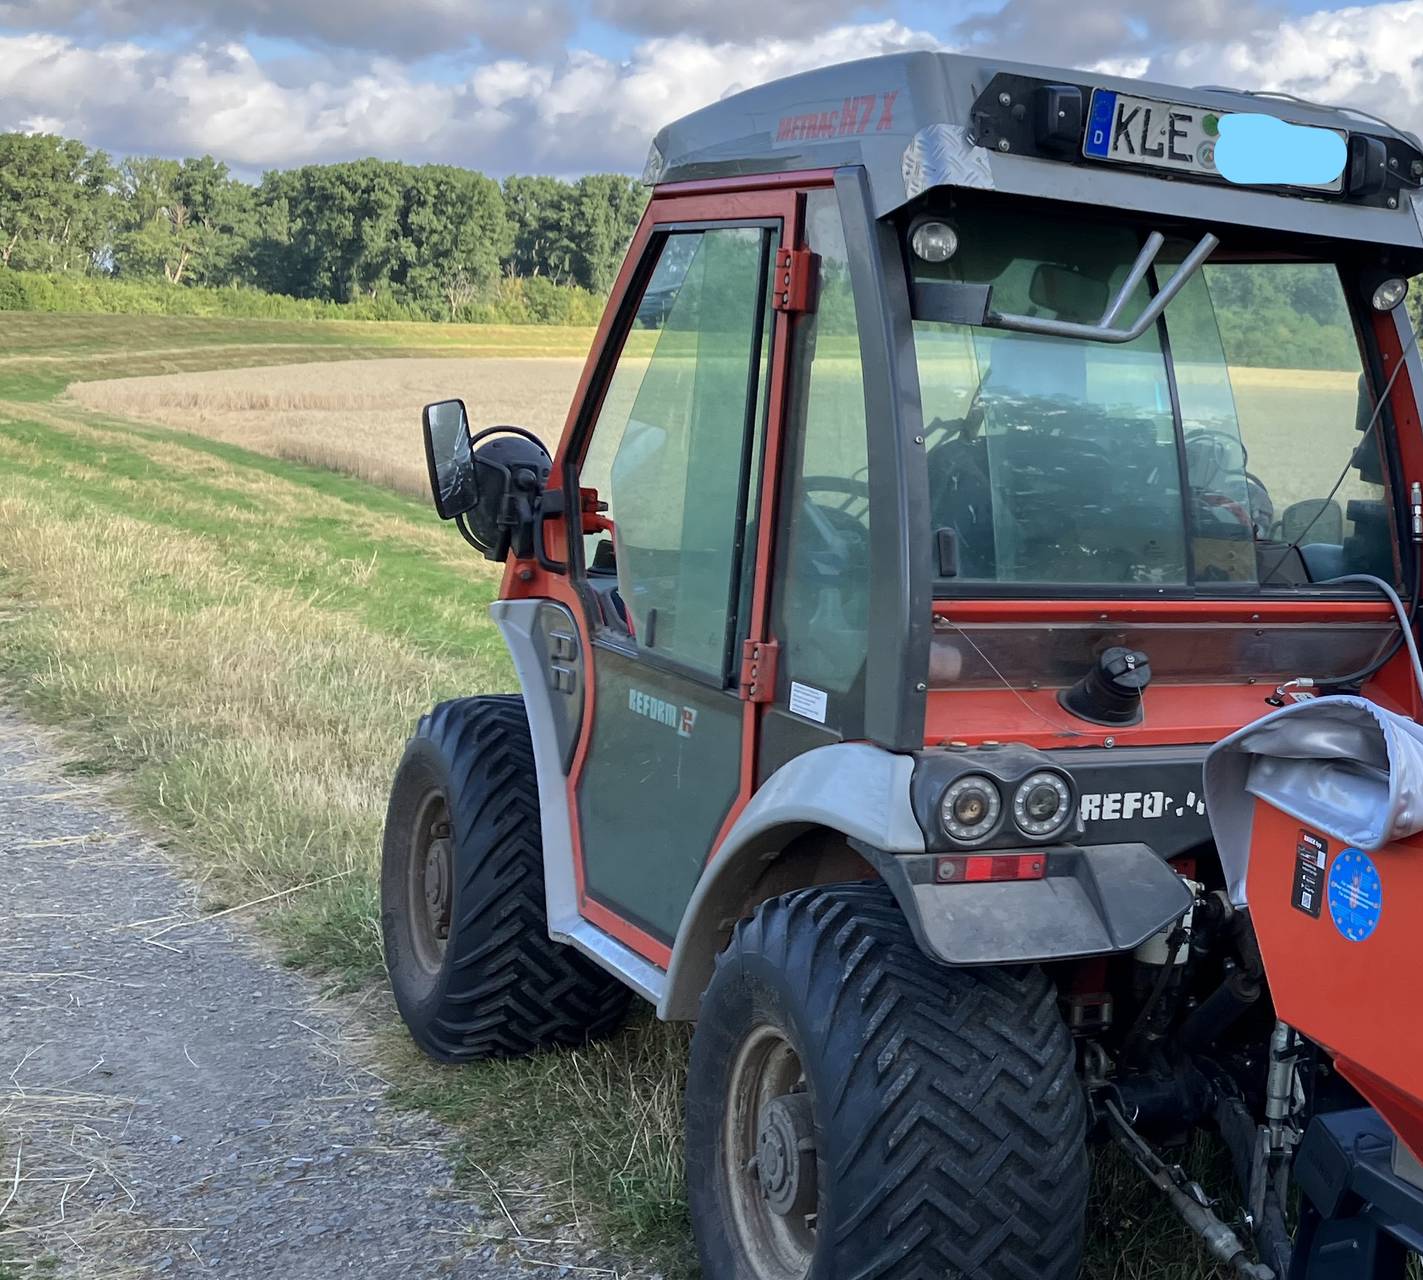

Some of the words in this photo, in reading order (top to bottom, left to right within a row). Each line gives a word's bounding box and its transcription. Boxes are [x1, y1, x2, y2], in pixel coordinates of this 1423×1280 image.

[1093, 130, 1104, 145] D
[1112, 102, 1194, 163] KLE
[628, 688, 678, 729] REFORM
[1080, 790, 1205, 821] REFO
